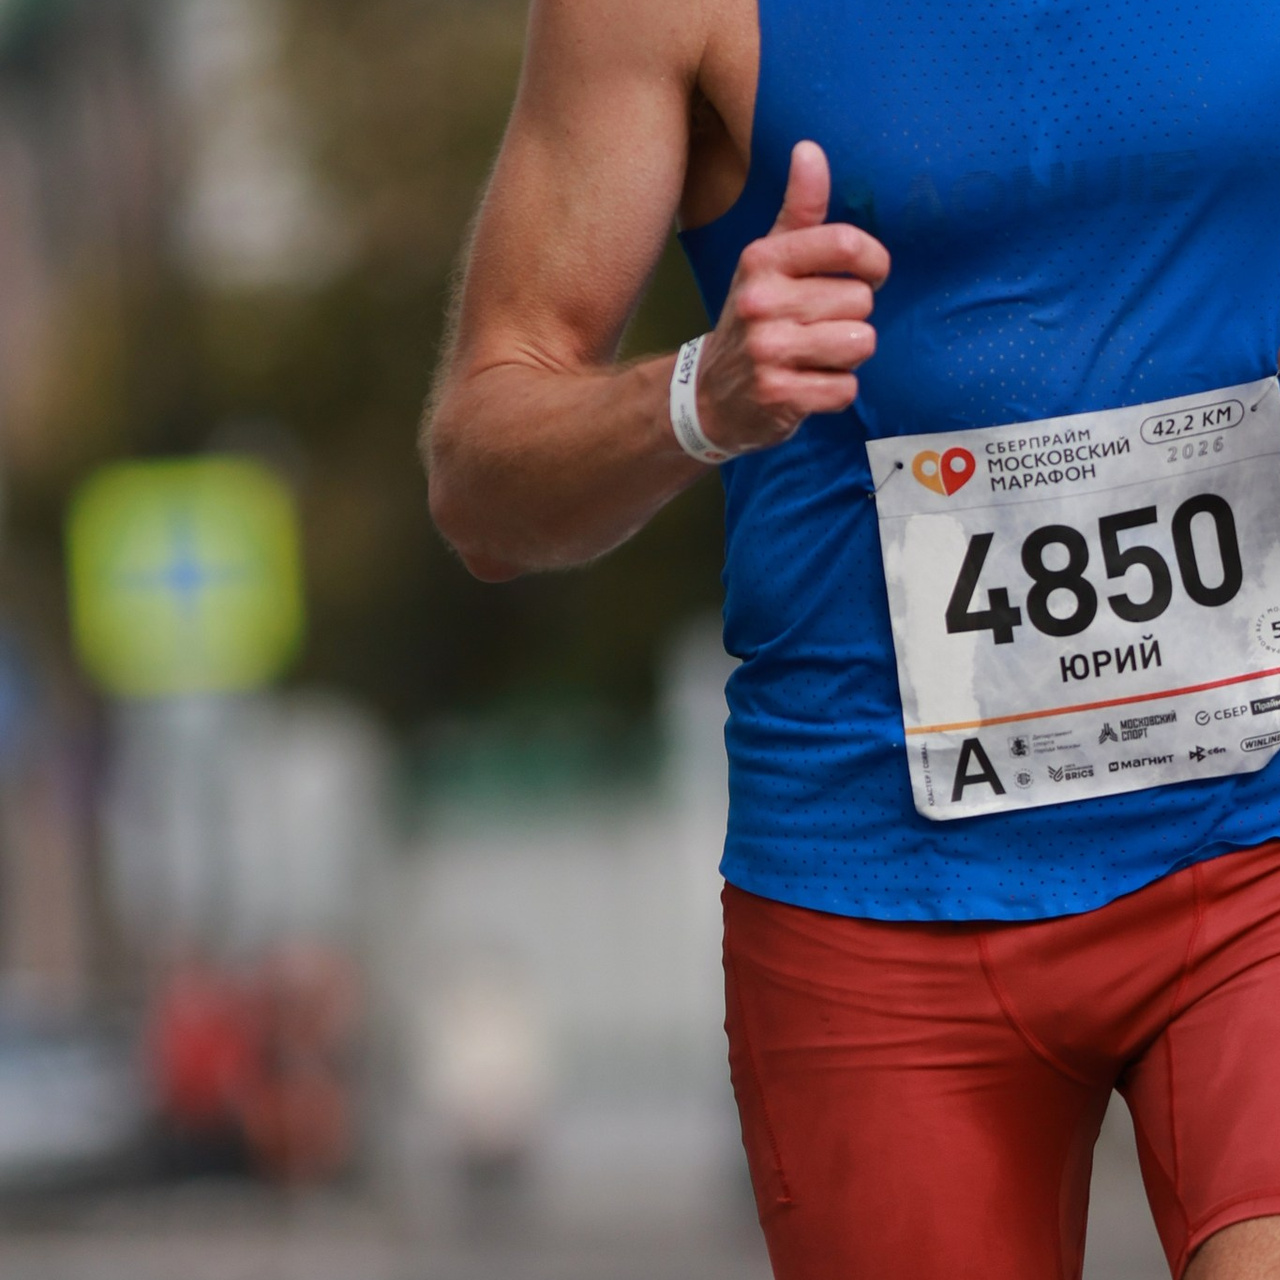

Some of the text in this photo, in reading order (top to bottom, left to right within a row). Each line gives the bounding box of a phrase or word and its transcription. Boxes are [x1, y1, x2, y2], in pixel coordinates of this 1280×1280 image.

[1152, 414, 1195, 437] 42,2
[984, 428, 1091, 455] СБЕРПРАЙМ
[987, 436, 1131, 474] МОСКОВСКИЙ
[1166, 436, 1225, 463] 2026
[990, 464, 1097, 492] МАРАФОН
[945, 493, 1243, 645] 4850
[1059, 634, 1163, 683] ЮРИЙ
[1120, 710, 1177, 730] МОСКОВСКИЙ
[1214, 705, 1248, 720] СБЕР
[1121, 728, 1148, 741] СПОРТ
[1065, 768, 1095, 782] BRICS
